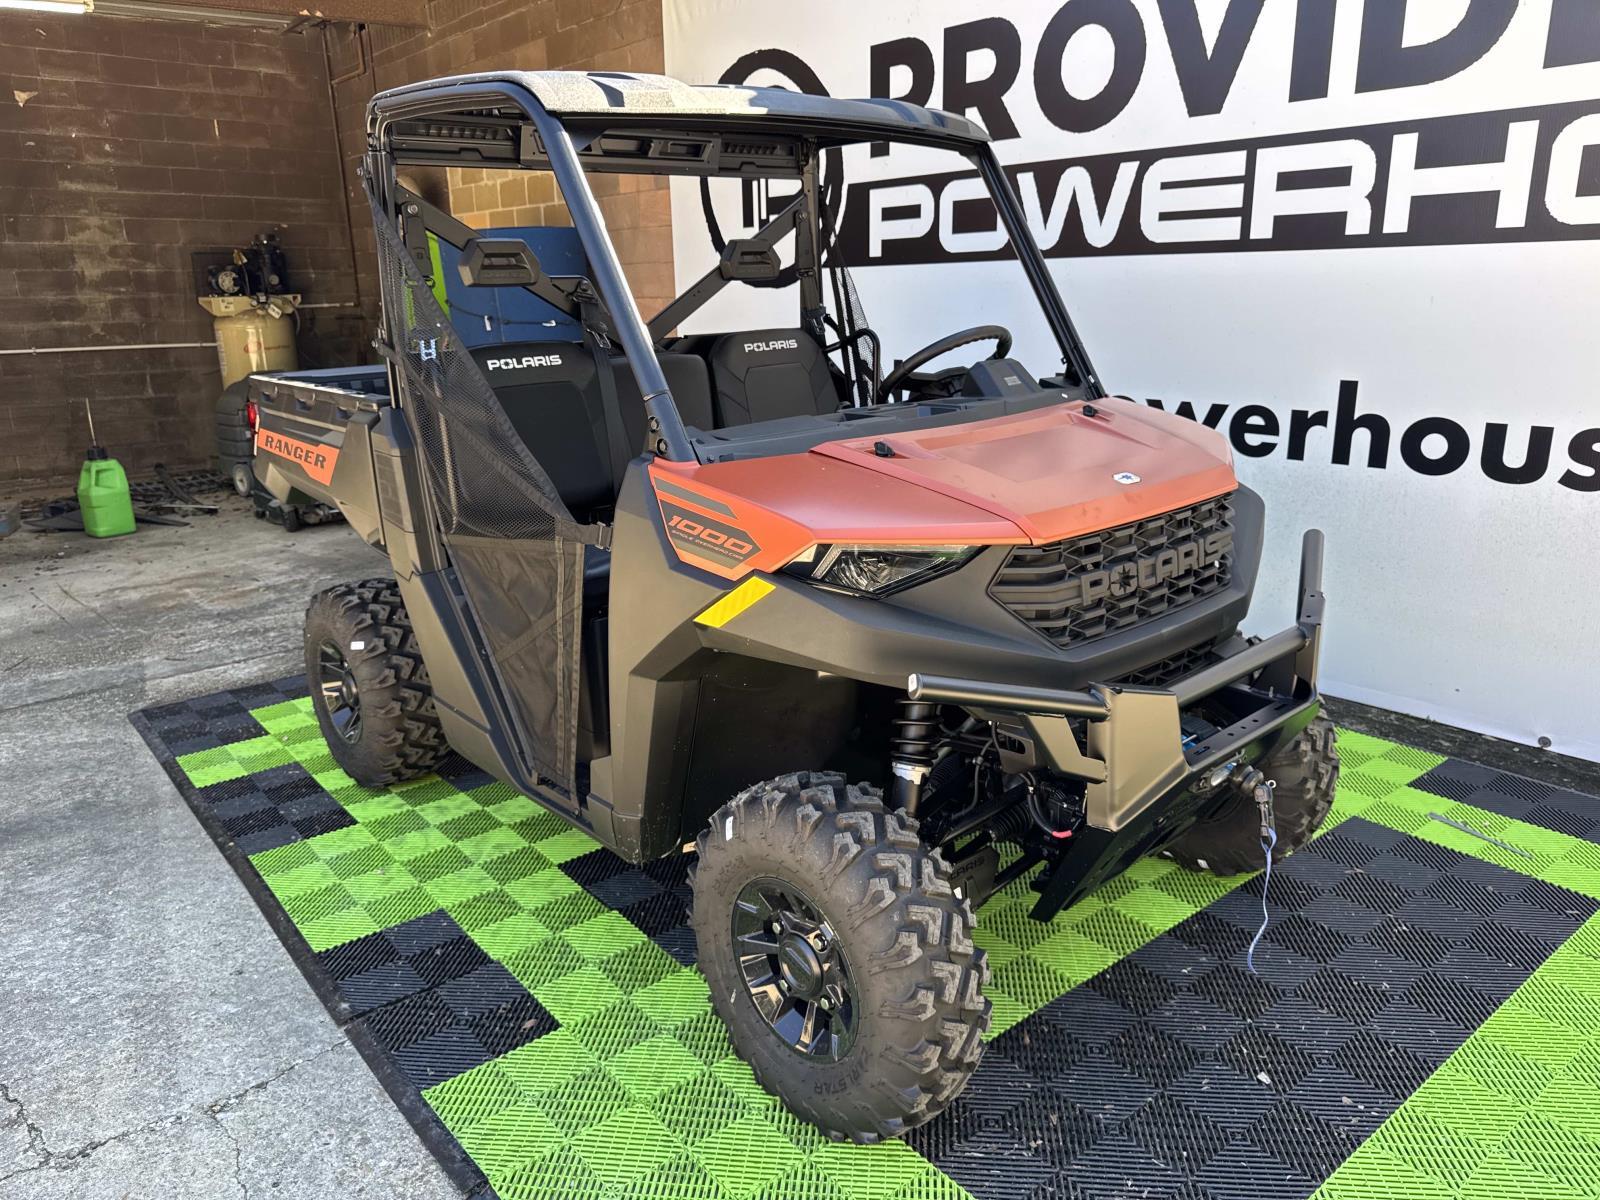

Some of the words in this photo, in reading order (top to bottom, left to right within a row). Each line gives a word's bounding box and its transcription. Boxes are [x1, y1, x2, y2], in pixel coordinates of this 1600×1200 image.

[487, 355, 562, 371] POLARIS
[744, 339, 798, 352] POLARIS
[264, 434, 327, 469] RANGER
[668, 515, 753, 554] 1000
[1081, 533, 1224, 606] POLARIS
